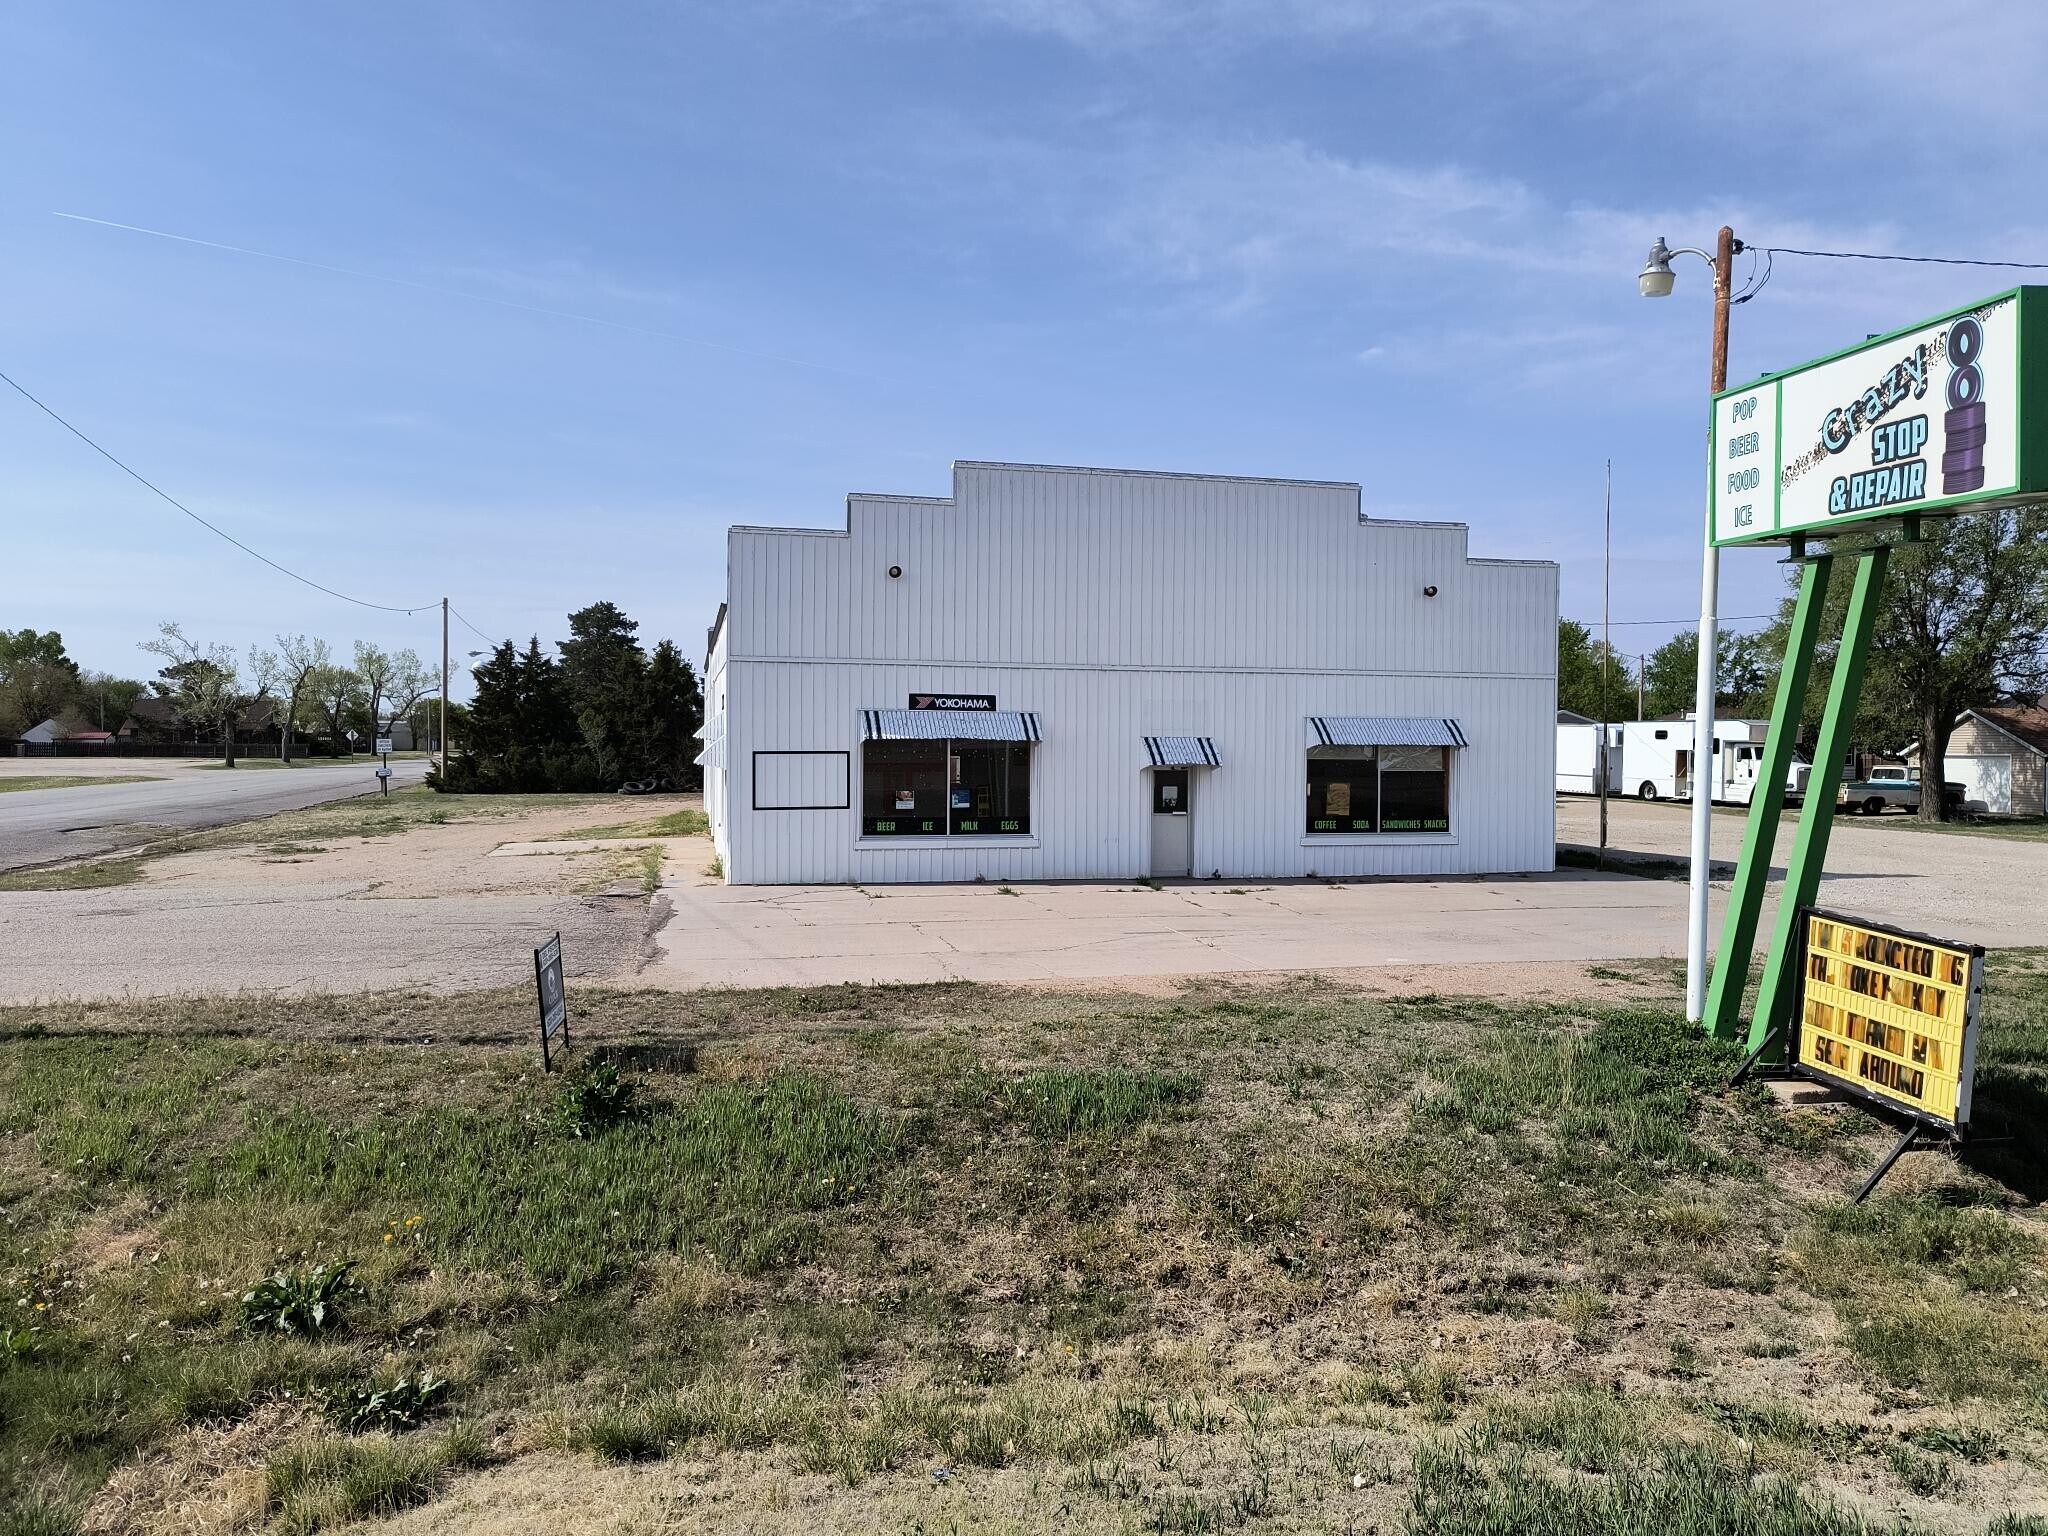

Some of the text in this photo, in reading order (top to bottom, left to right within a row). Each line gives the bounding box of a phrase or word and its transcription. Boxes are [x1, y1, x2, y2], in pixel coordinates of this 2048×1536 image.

[1732, 397, 1758, 424] POP
[1822, 346, 1928, 454] Crazy
[1728, 432, 1760, 459] BEER
[1872, 416, 1928, 465] STOP
[1727, 468, 1760, 494] FOOD
[1830, 461, 1926, 515] & REPAIR
[1734, 504, 1753, 528] ICE
[934, 698, 990, 709] YOKOHAMA
[876, 821, 934, 832] BEER ICE
[961, 820, 1019, 831] MILK EGGS
[1314, 820, 1370, 830] COFFEE SODA
[1382, 819, 1447, 829] SANDWICHES SNACKS
